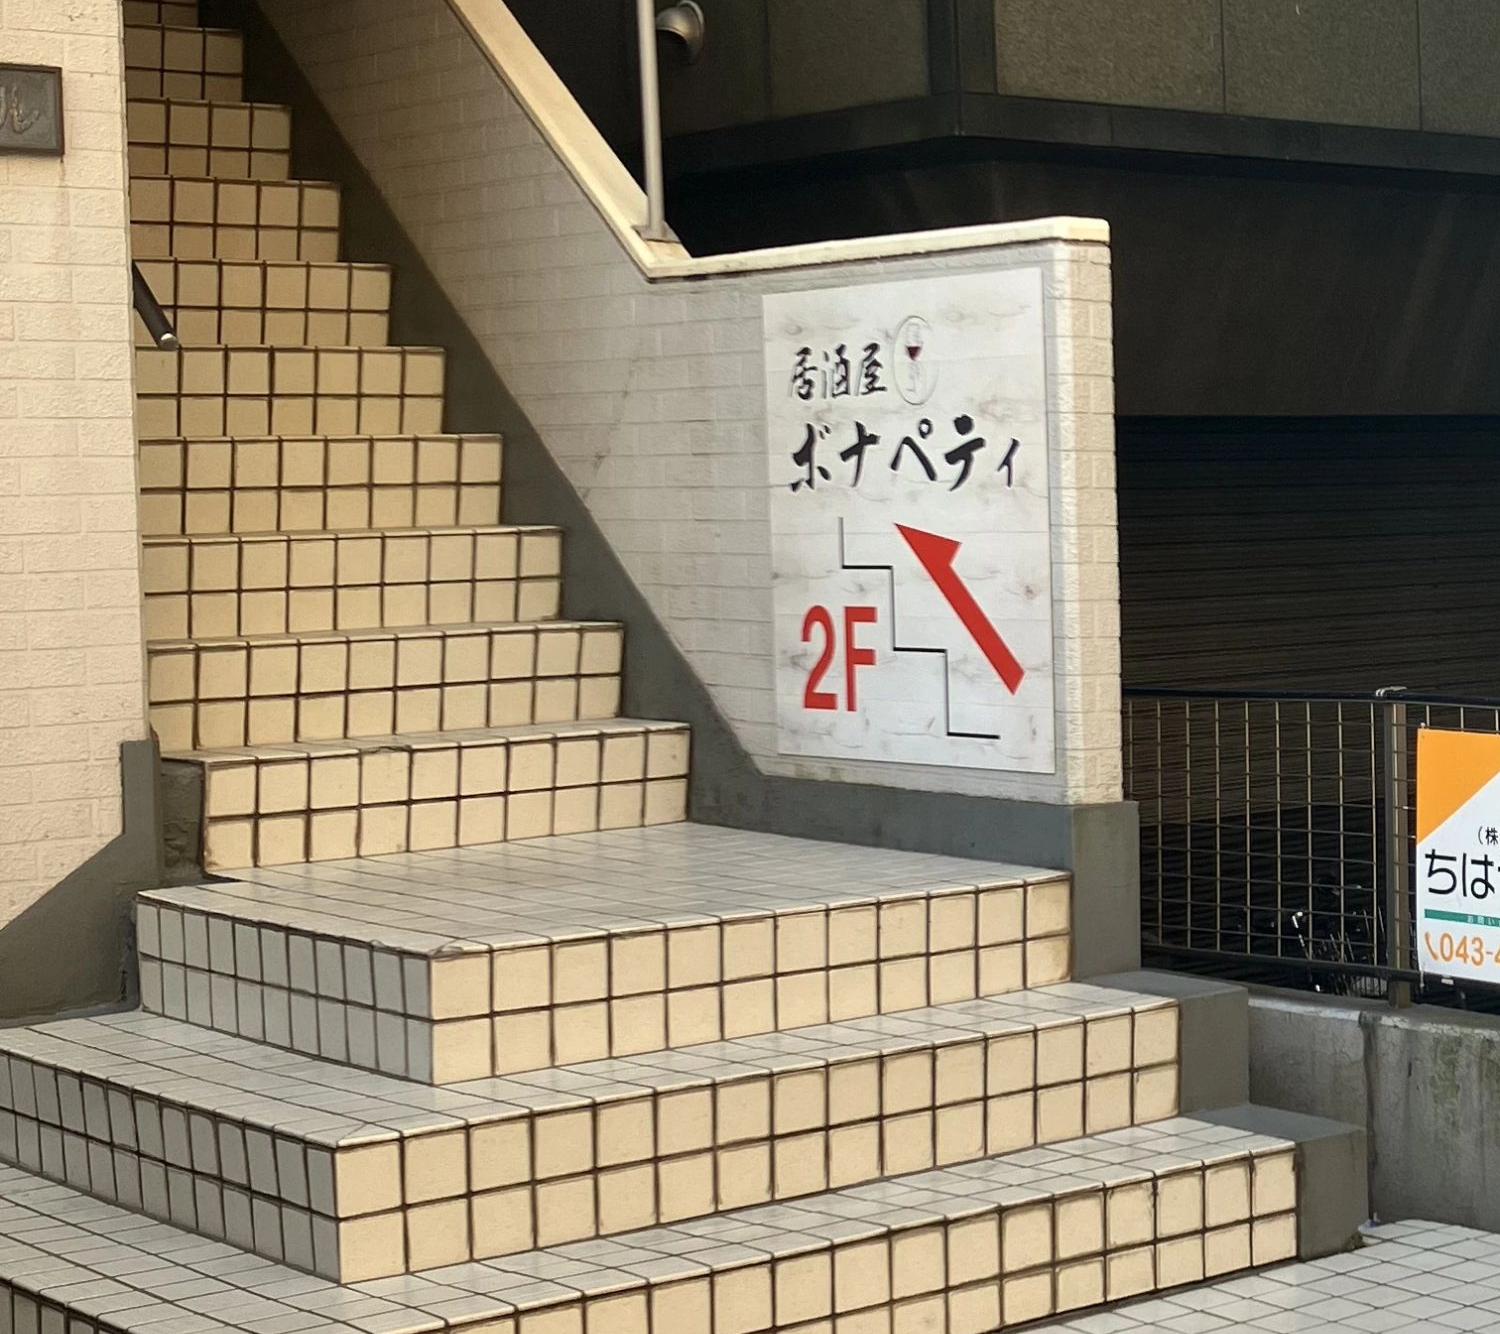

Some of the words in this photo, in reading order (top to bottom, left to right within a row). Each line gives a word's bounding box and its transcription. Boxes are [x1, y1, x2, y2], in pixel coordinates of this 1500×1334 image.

[787, 342, 888, 401] 居酒屋
[790, 414, 1021, 493] ボナペティ
[801, 605, 878, 712] 2F
